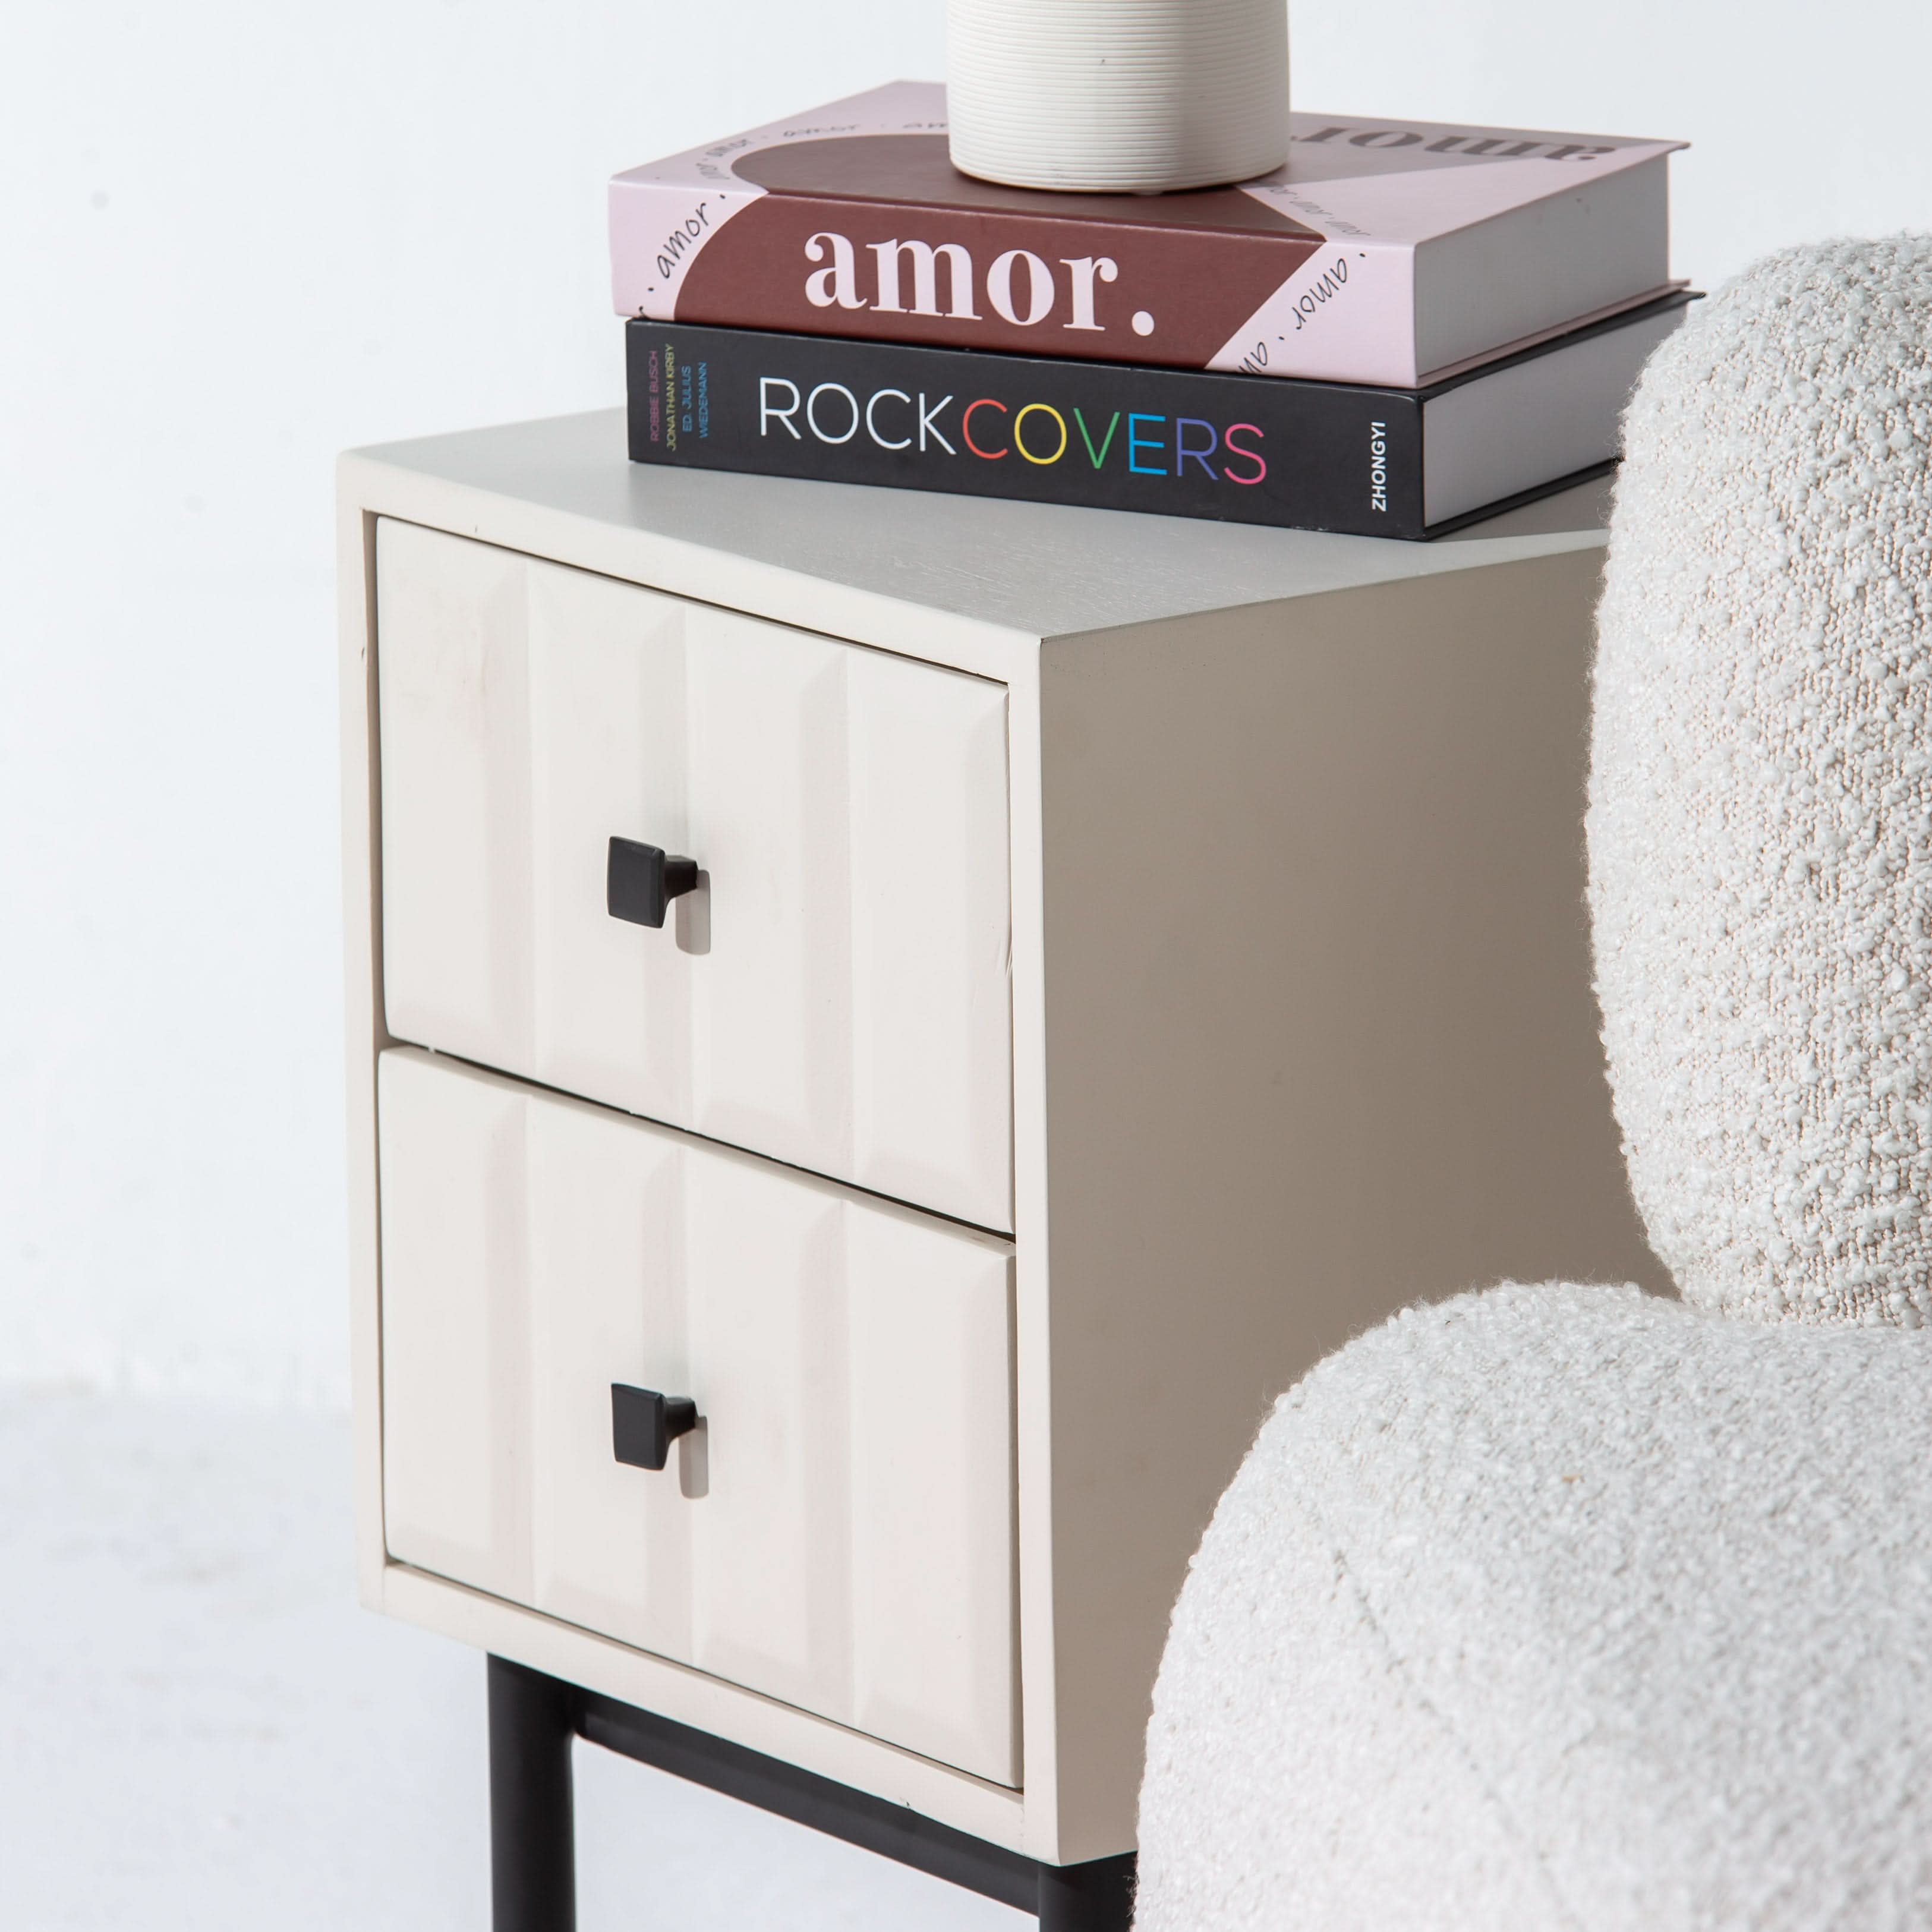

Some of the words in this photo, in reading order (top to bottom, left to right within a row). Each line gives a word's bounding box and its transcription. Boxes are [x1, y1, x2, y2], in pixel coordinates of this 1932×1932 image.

[657, 202, 708, 279] amor
[804, 232, 1155, 336] amor.
[1291, 258, 1347, 329] amor
[664, 343, 675, 379] KIRBY
[681, 365, 692, 409] JULIUS
[666, 381, 676, 452] JONATHAN
[698, 361, 709, 439] WIEDEMANN
[1371, 421, 1386, 512] ZHONGYI
